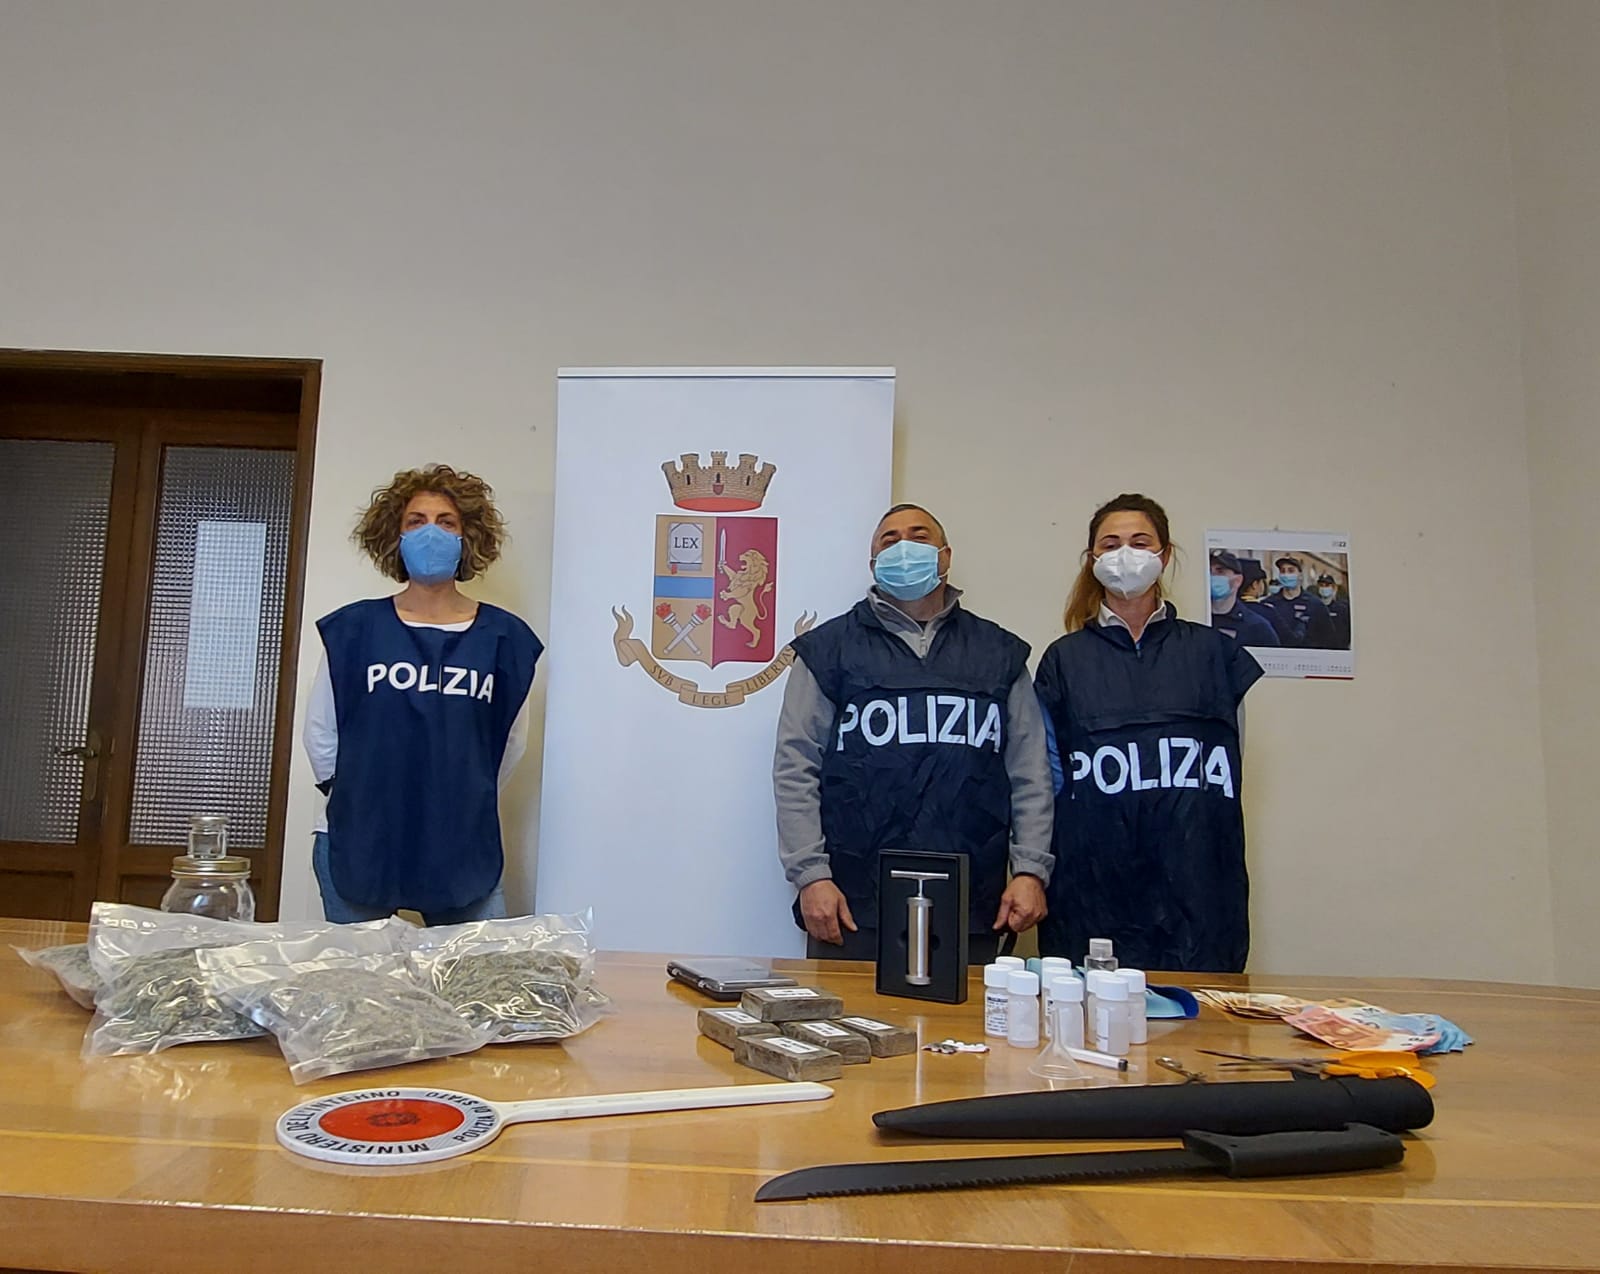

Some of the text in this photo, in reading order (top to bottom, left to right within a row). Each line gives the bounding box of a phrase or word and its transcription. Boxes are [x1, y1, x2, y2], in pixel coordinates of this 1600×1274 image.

[674, 536, 699, 549] LEX
[650, 664, 674, 687] SVB
[692, 693, 730, 706] LEGE
[836, 695, 1001, 753] POLIZIA
[286, 1090, 430, 1154] MINISTERO DELL'INTERNO
[424, 1091, 496, 1142] POLIZIA DI STATO
